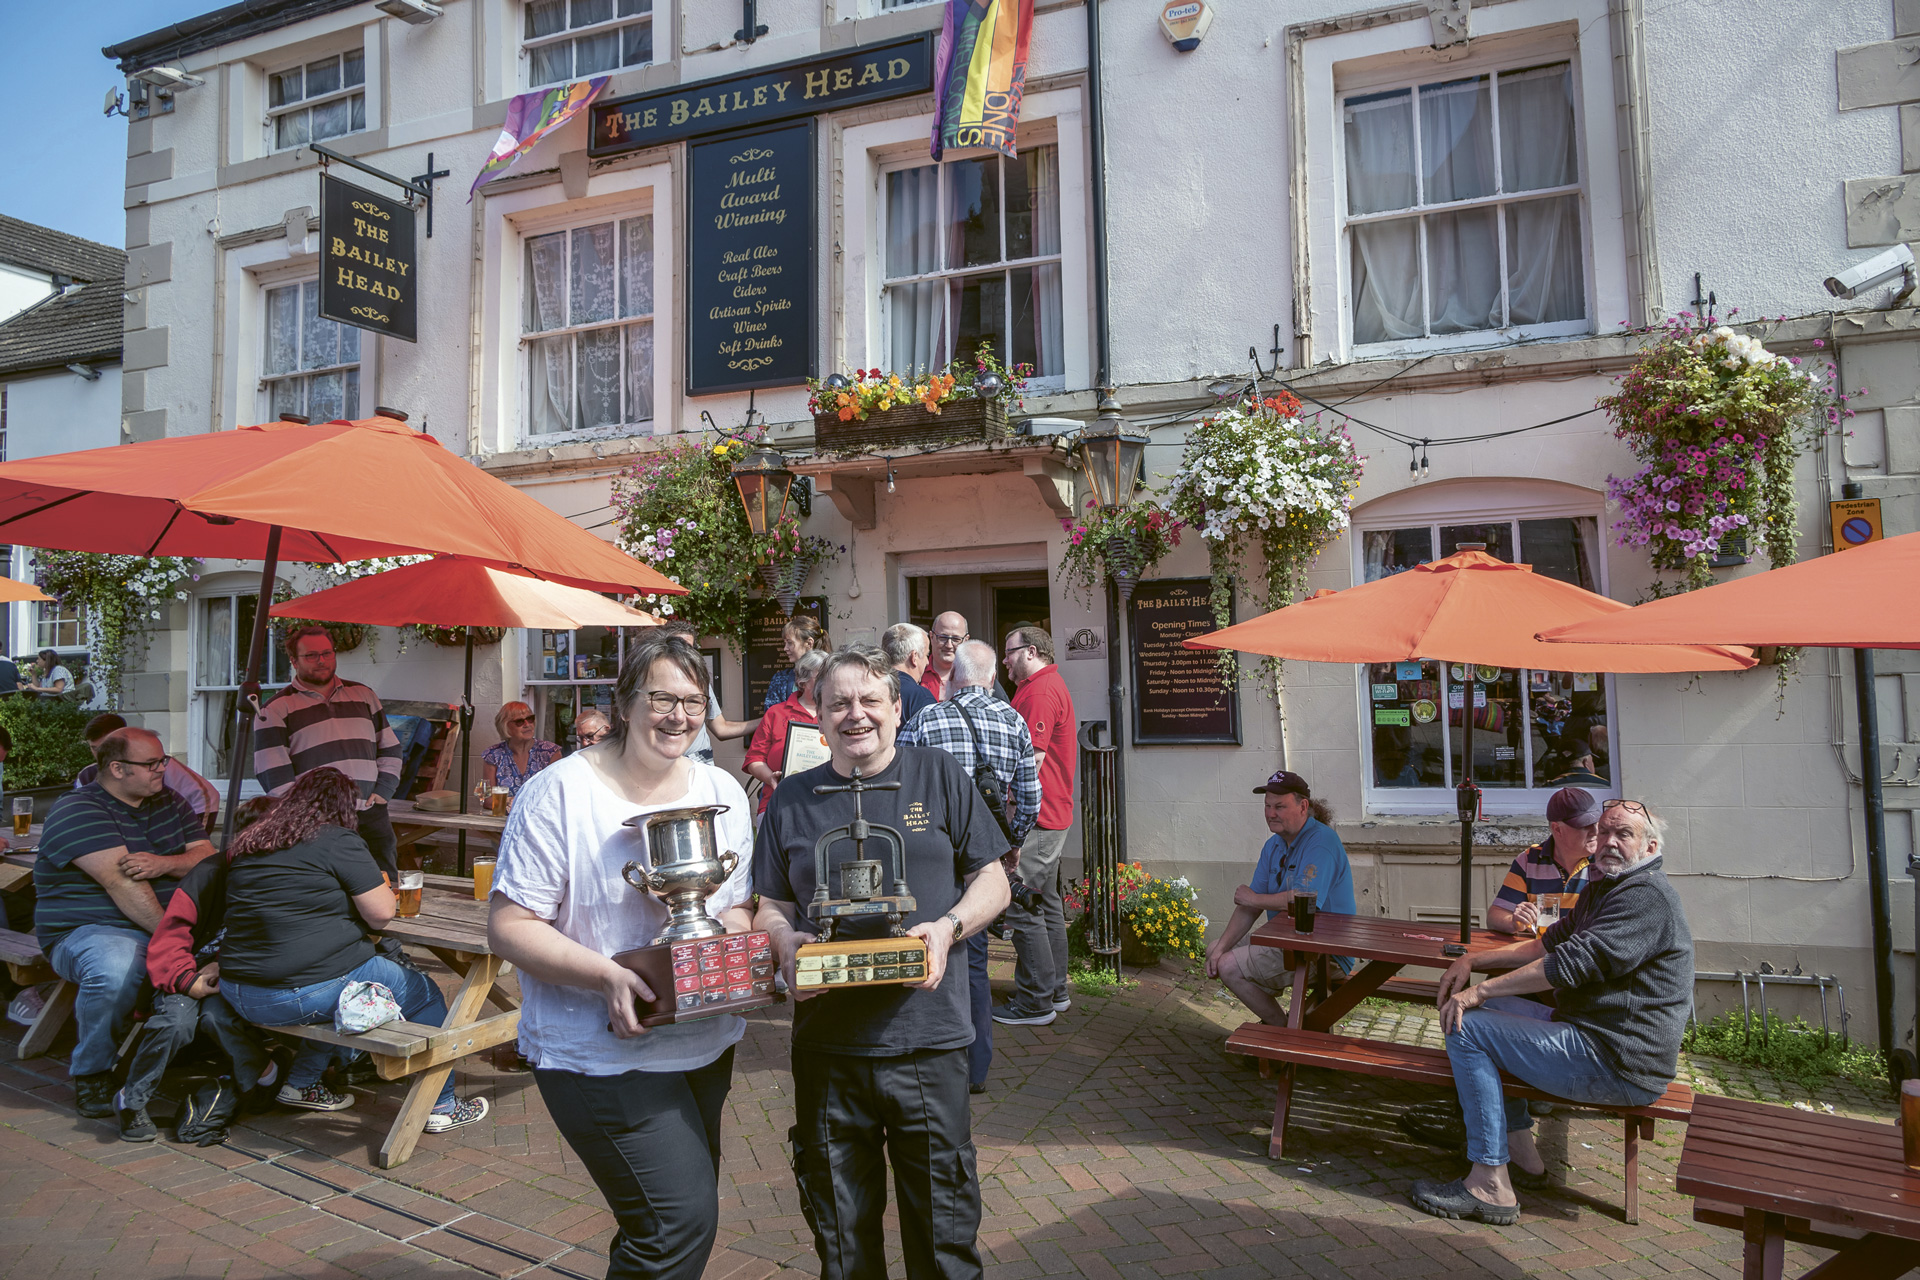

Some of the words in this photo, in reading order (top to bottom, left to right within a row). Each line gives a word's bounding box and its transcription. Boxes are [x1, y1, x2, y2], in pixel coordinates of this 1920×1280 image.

[1169, 5, 1198, 17] Pro-tek
[941, 24, 978, 148] WELCOME
[606, 108, 658, 139] THE
[668, 81, 791, 127] BAILEY
[804, 58, 911, 99] HEAD
[981, 92, 1010, 149] ONE
[957, 122, 982, 146] IS
[725, 167, 776, 189] Multi
[720, 184, 780, 209] Award
[354, 217, 389, 243] THE
[714, 209, 787, 230] Winning
[331, 236, 409, 277] BAILEY
[722, 248, 750, 264] Real
[753, 245, 778, 259] Ales
[718, 267, 748, 283] Craft
[751, 264, 782, 278] Beers
[733, 284, 767, 298] Ciders
[709, 306, 751, 319] Artisan
[754, 298, 791, 316] Spirits
[733, 321, 767, 334] Wines
[718, 340, 741, 356] Soft
[744, 334, 783, 351] Drinks
[1137, 599, 1154, 609] THE
[1156, 598, 1191, 609] BAILEY
[750, 617, 763, 627] THE
[1151, 621, 1186, 631] Opening
[903, 812, 930, 820] BAILEY
